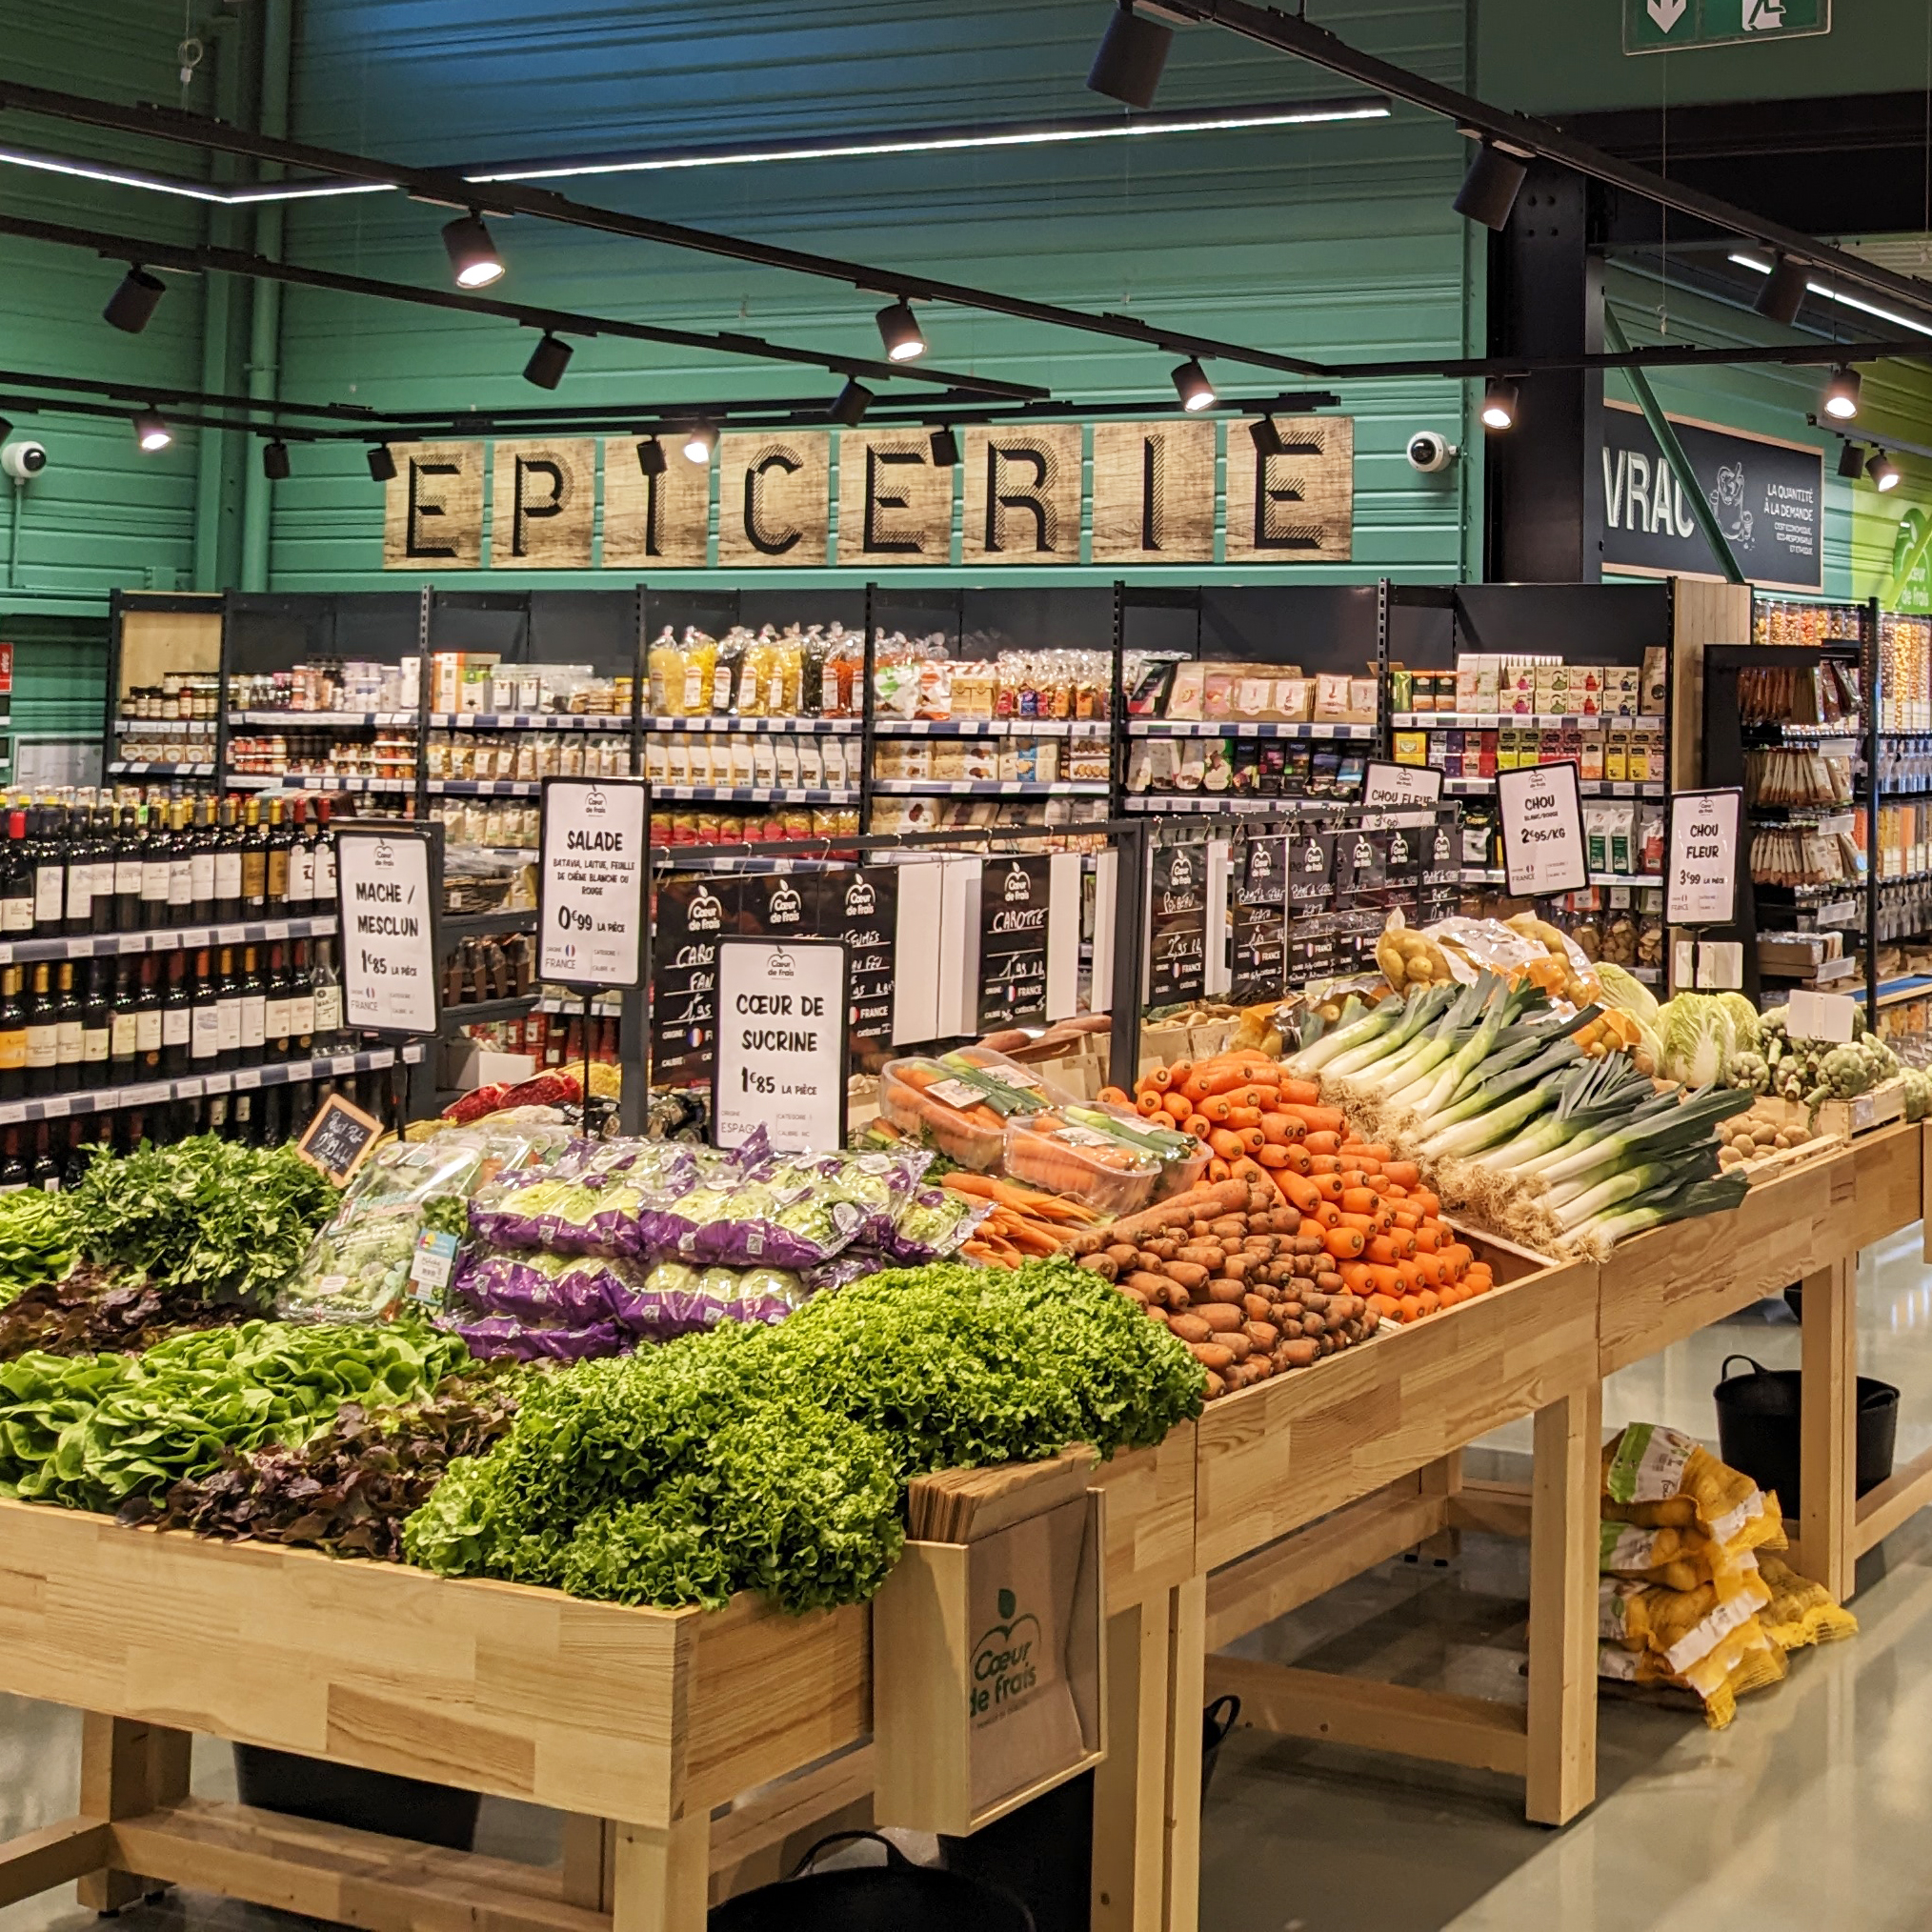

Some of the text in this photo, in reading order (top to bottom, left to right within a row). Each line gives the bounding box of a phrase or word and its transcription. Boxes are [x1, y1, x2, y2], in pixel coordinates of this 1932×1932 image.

[406, 433, 1323, 557] EPICERIE
[1767, 484, 1777, 496] LA
[1770, 503, 1780, 515] LA
[1781, 504, 1814, 521] DEMANDE
[1372, 789, 1399, 802] CHOU
[1524, 795, 1555, 811] CHOU
[1690, 824, 1719, 837] CHOU
[567, 830, 623, 852] SALADE
[1686, 845, 1720, 858] FLEUR
[557, 872, 565, 880] DE
[590, 874, 617, 883] BLANCHE
[355, 882, 402, 903] MACHE
[581, 886, 603, 896] ROUGE
[851, 892, 872, 904] Cœur
[774, 898, 797, 912] Cœur
[846, 904, 875, 916] de frais
[769, 911, 800, 924] de frais
[993, 906, 1049, 933] CAROTTE
[357, 916, 418, 936] MESCLUN
[597, 923, 606, 932] LA
[689, 919, 701, 932] de
[545, 958, 576, 970] FRANCE
[771, 959, 791, 968] Cœur
[392, 966, 399, 976] LA
[1017, 984, 1043, 997] FRANCE
[351, 1000, 379, 1011] FRANCE
[801, 996, 824, 1016] DE
[860, 1006, 889, 1019] FRANCE
[741, 1029, 817, 1052] SUCRINE
[781, 1084, 792, 1095] LA
[795, 1082, 817, 1096] PIÈCE
[975, 1641, 1033, 1681] Cœur
[995, 1661, 1037, 1704] frais
